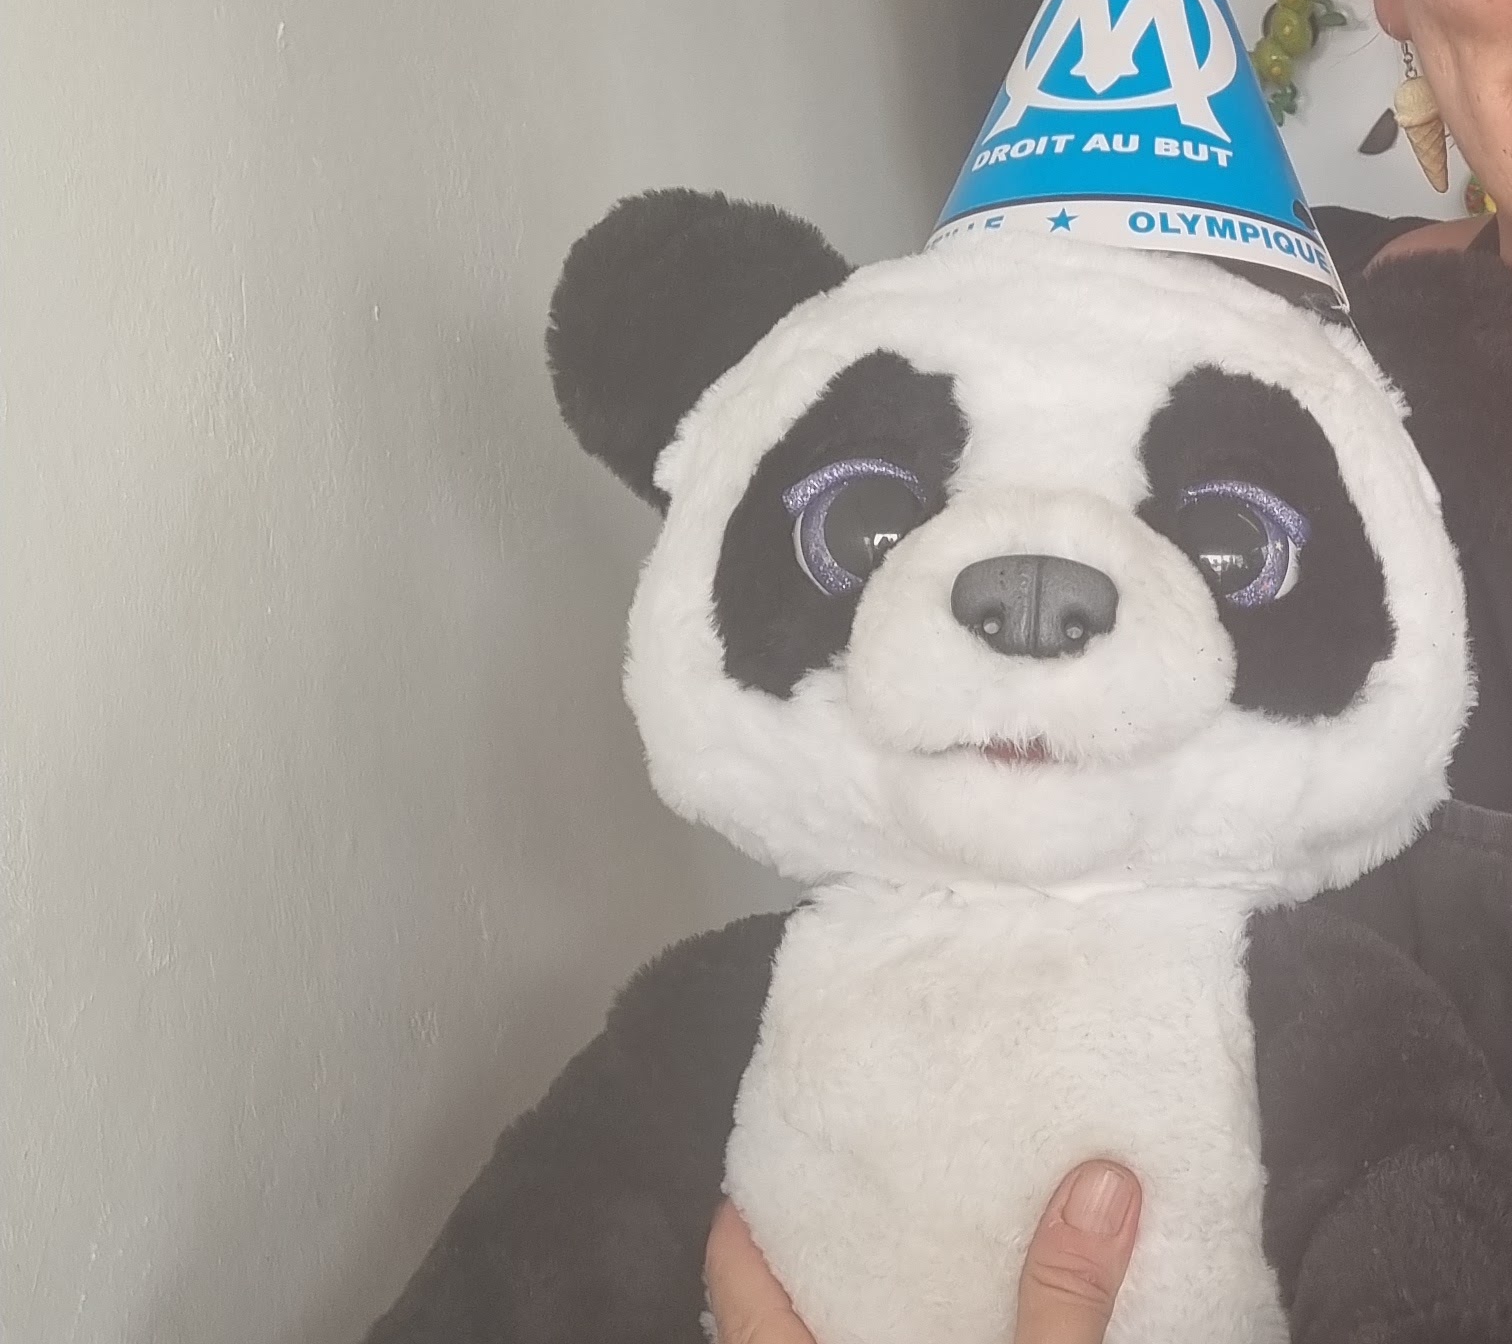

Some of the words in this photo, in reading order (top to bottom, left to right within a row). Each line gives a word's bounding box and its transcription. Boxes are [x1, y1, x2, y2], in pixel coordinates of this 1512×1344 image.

[971, 134, 1075, 172] DROIT
[1081, 133, 1140, 153] AU
[1153, 137, 1233, 168] BUT
[1127, 211, 1332, 275] OLYMPIQUE
